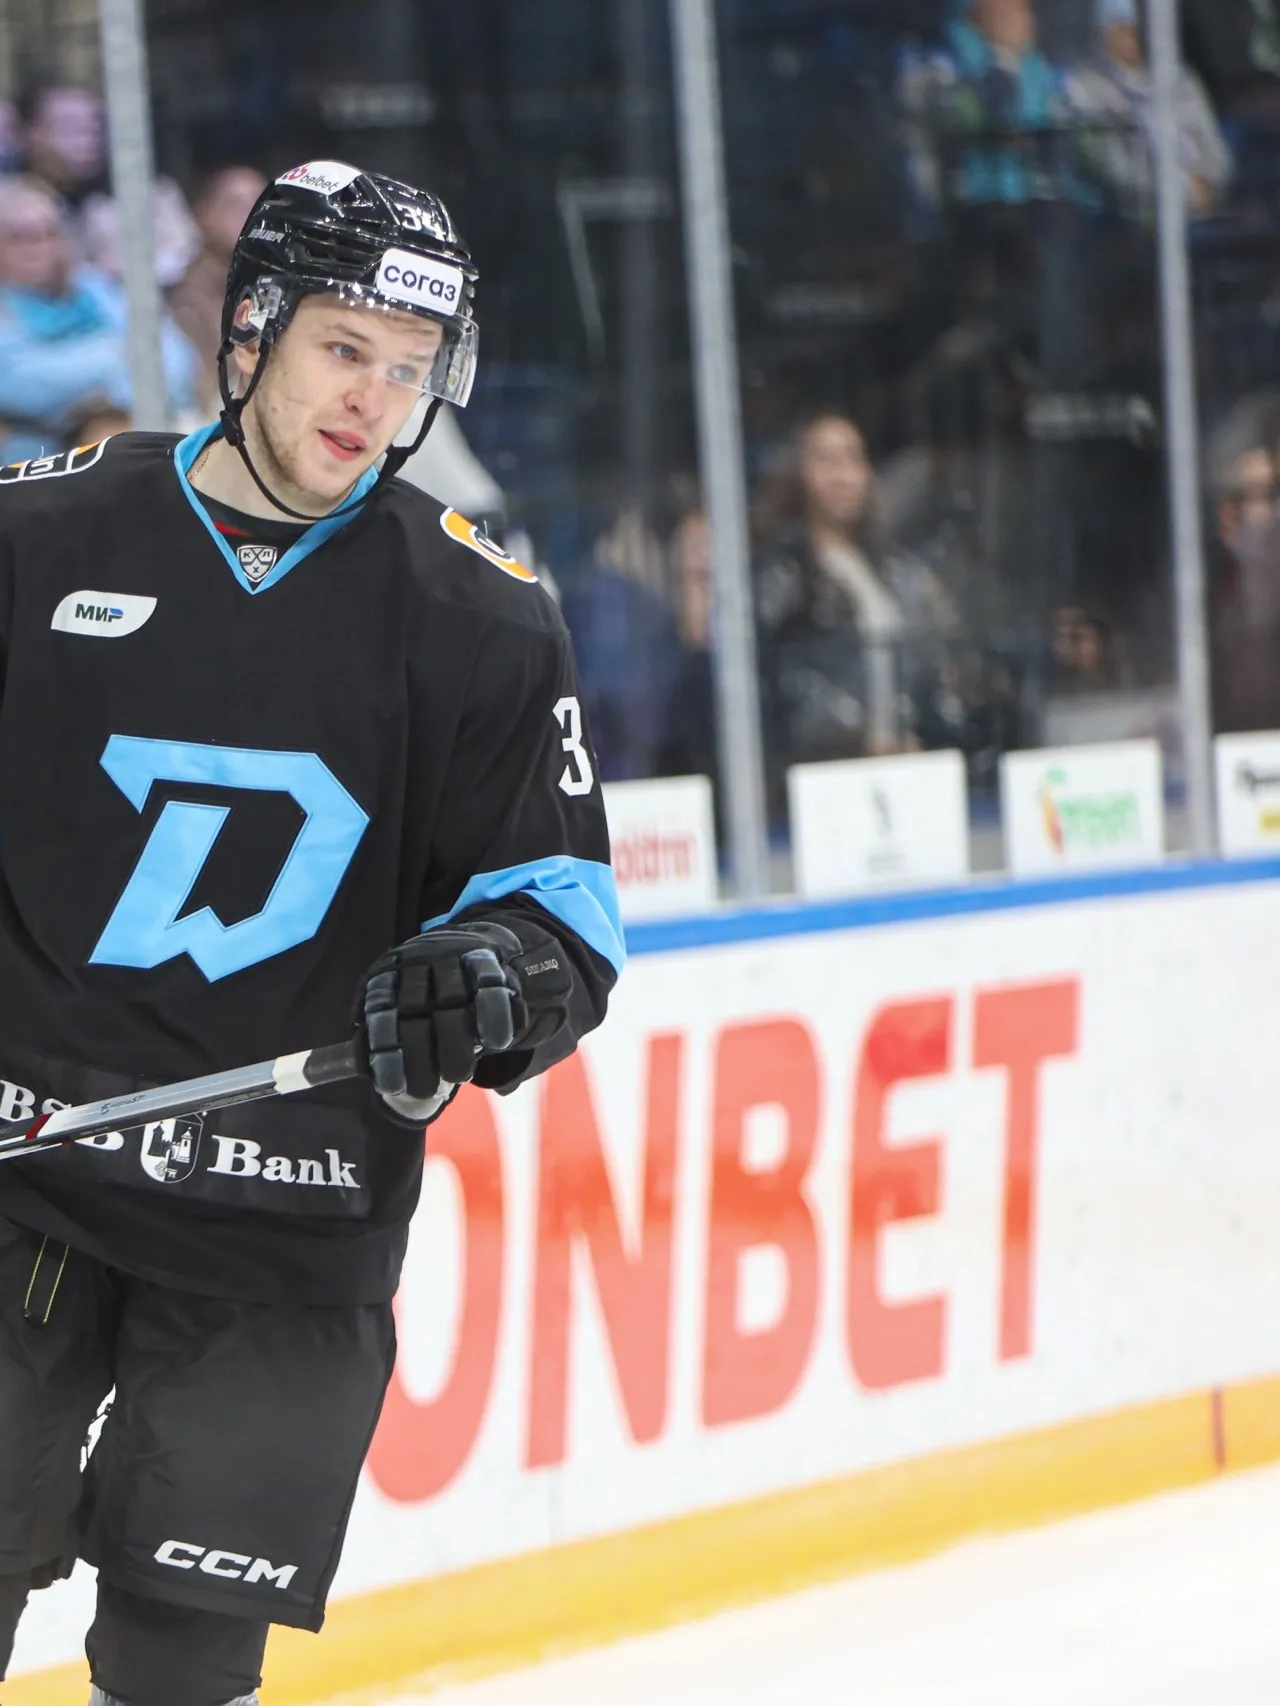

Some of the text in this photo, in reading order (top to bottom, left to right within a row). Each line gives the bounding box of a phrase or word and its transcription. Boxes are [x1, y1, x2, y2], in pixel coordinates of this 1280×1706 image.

[383, 264, 456, 302] согаз
[74, 603, 124, 623] МИР
[207, 1134, 361, 1189] Bank
[153, 1539, 299, 1590] CCM
